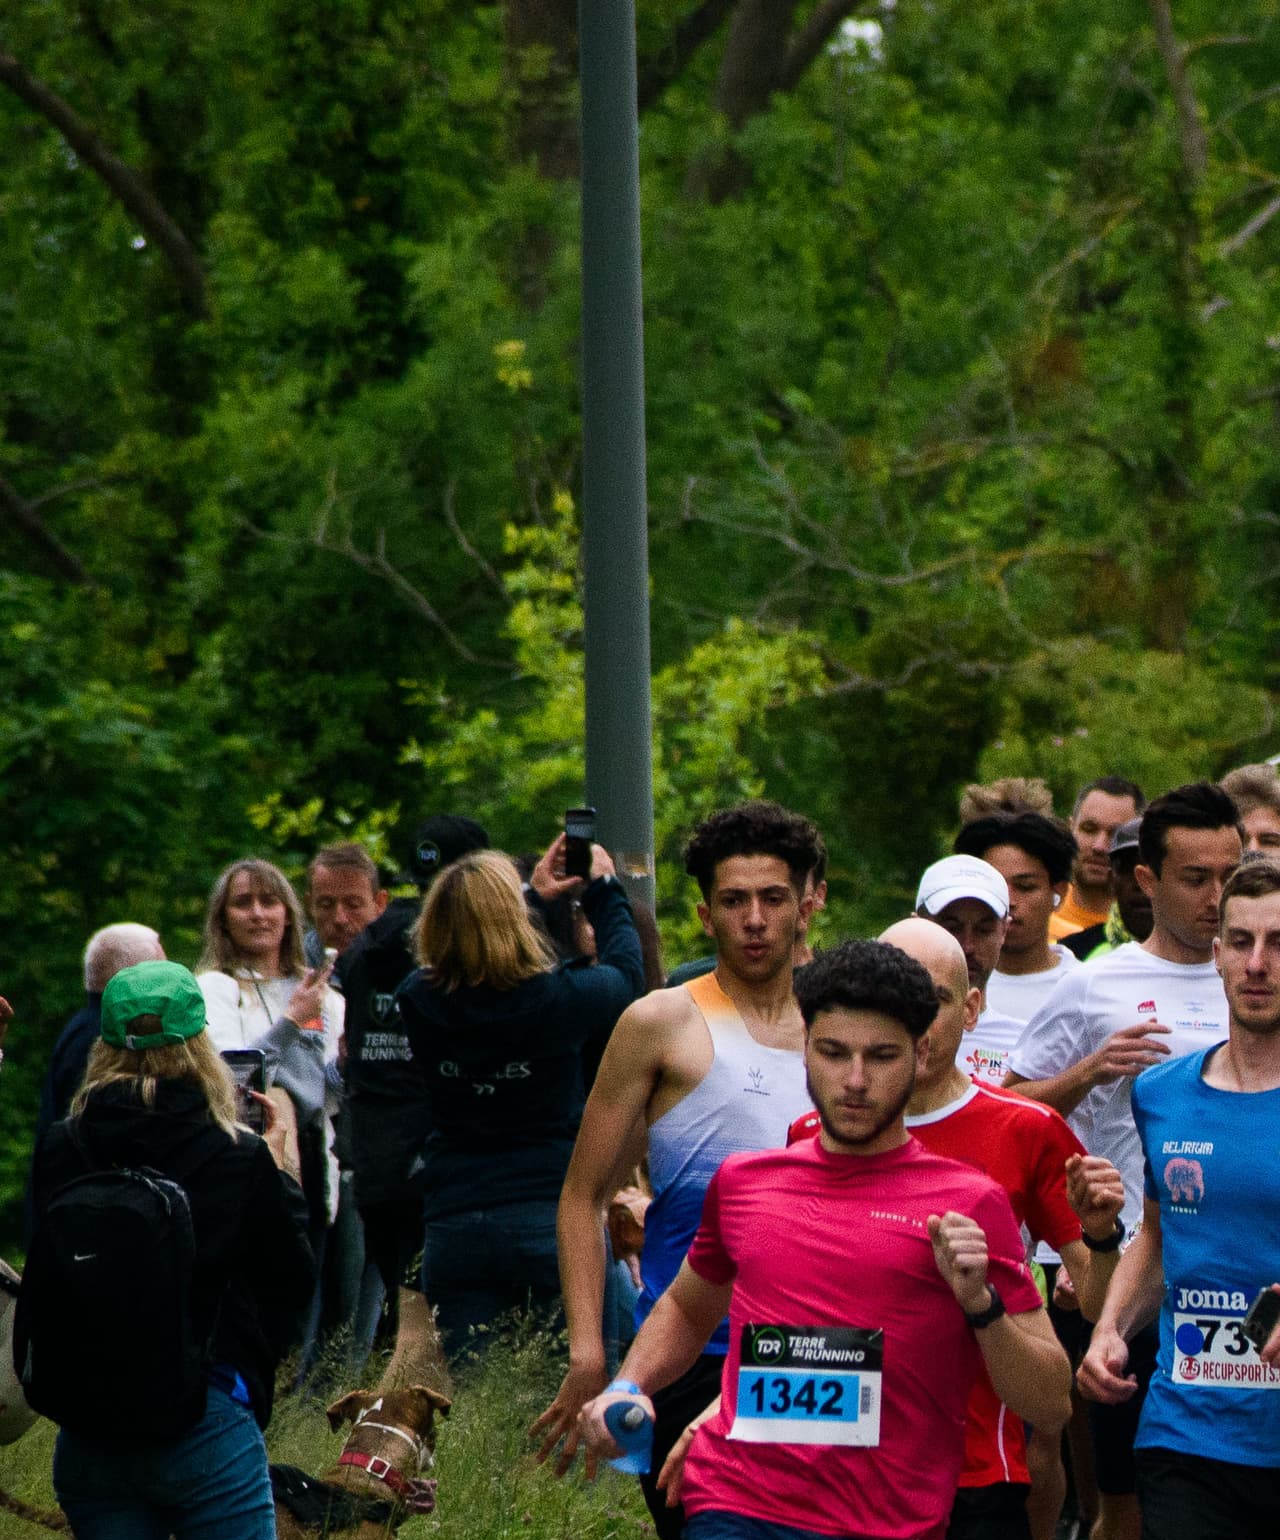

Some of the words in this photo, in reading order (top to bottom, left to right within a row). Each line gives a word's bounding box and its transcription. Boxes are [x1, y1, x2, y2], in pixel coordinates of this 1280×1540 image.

[757, 1339, 782, 1354] TDR
[788, 1335, 826, 1350] TERRE
[791, 1348, 804, 1358] DE
[803, 1348, 865, 1362] RUNNING
[750, 1376, 845, 1417] 1342
